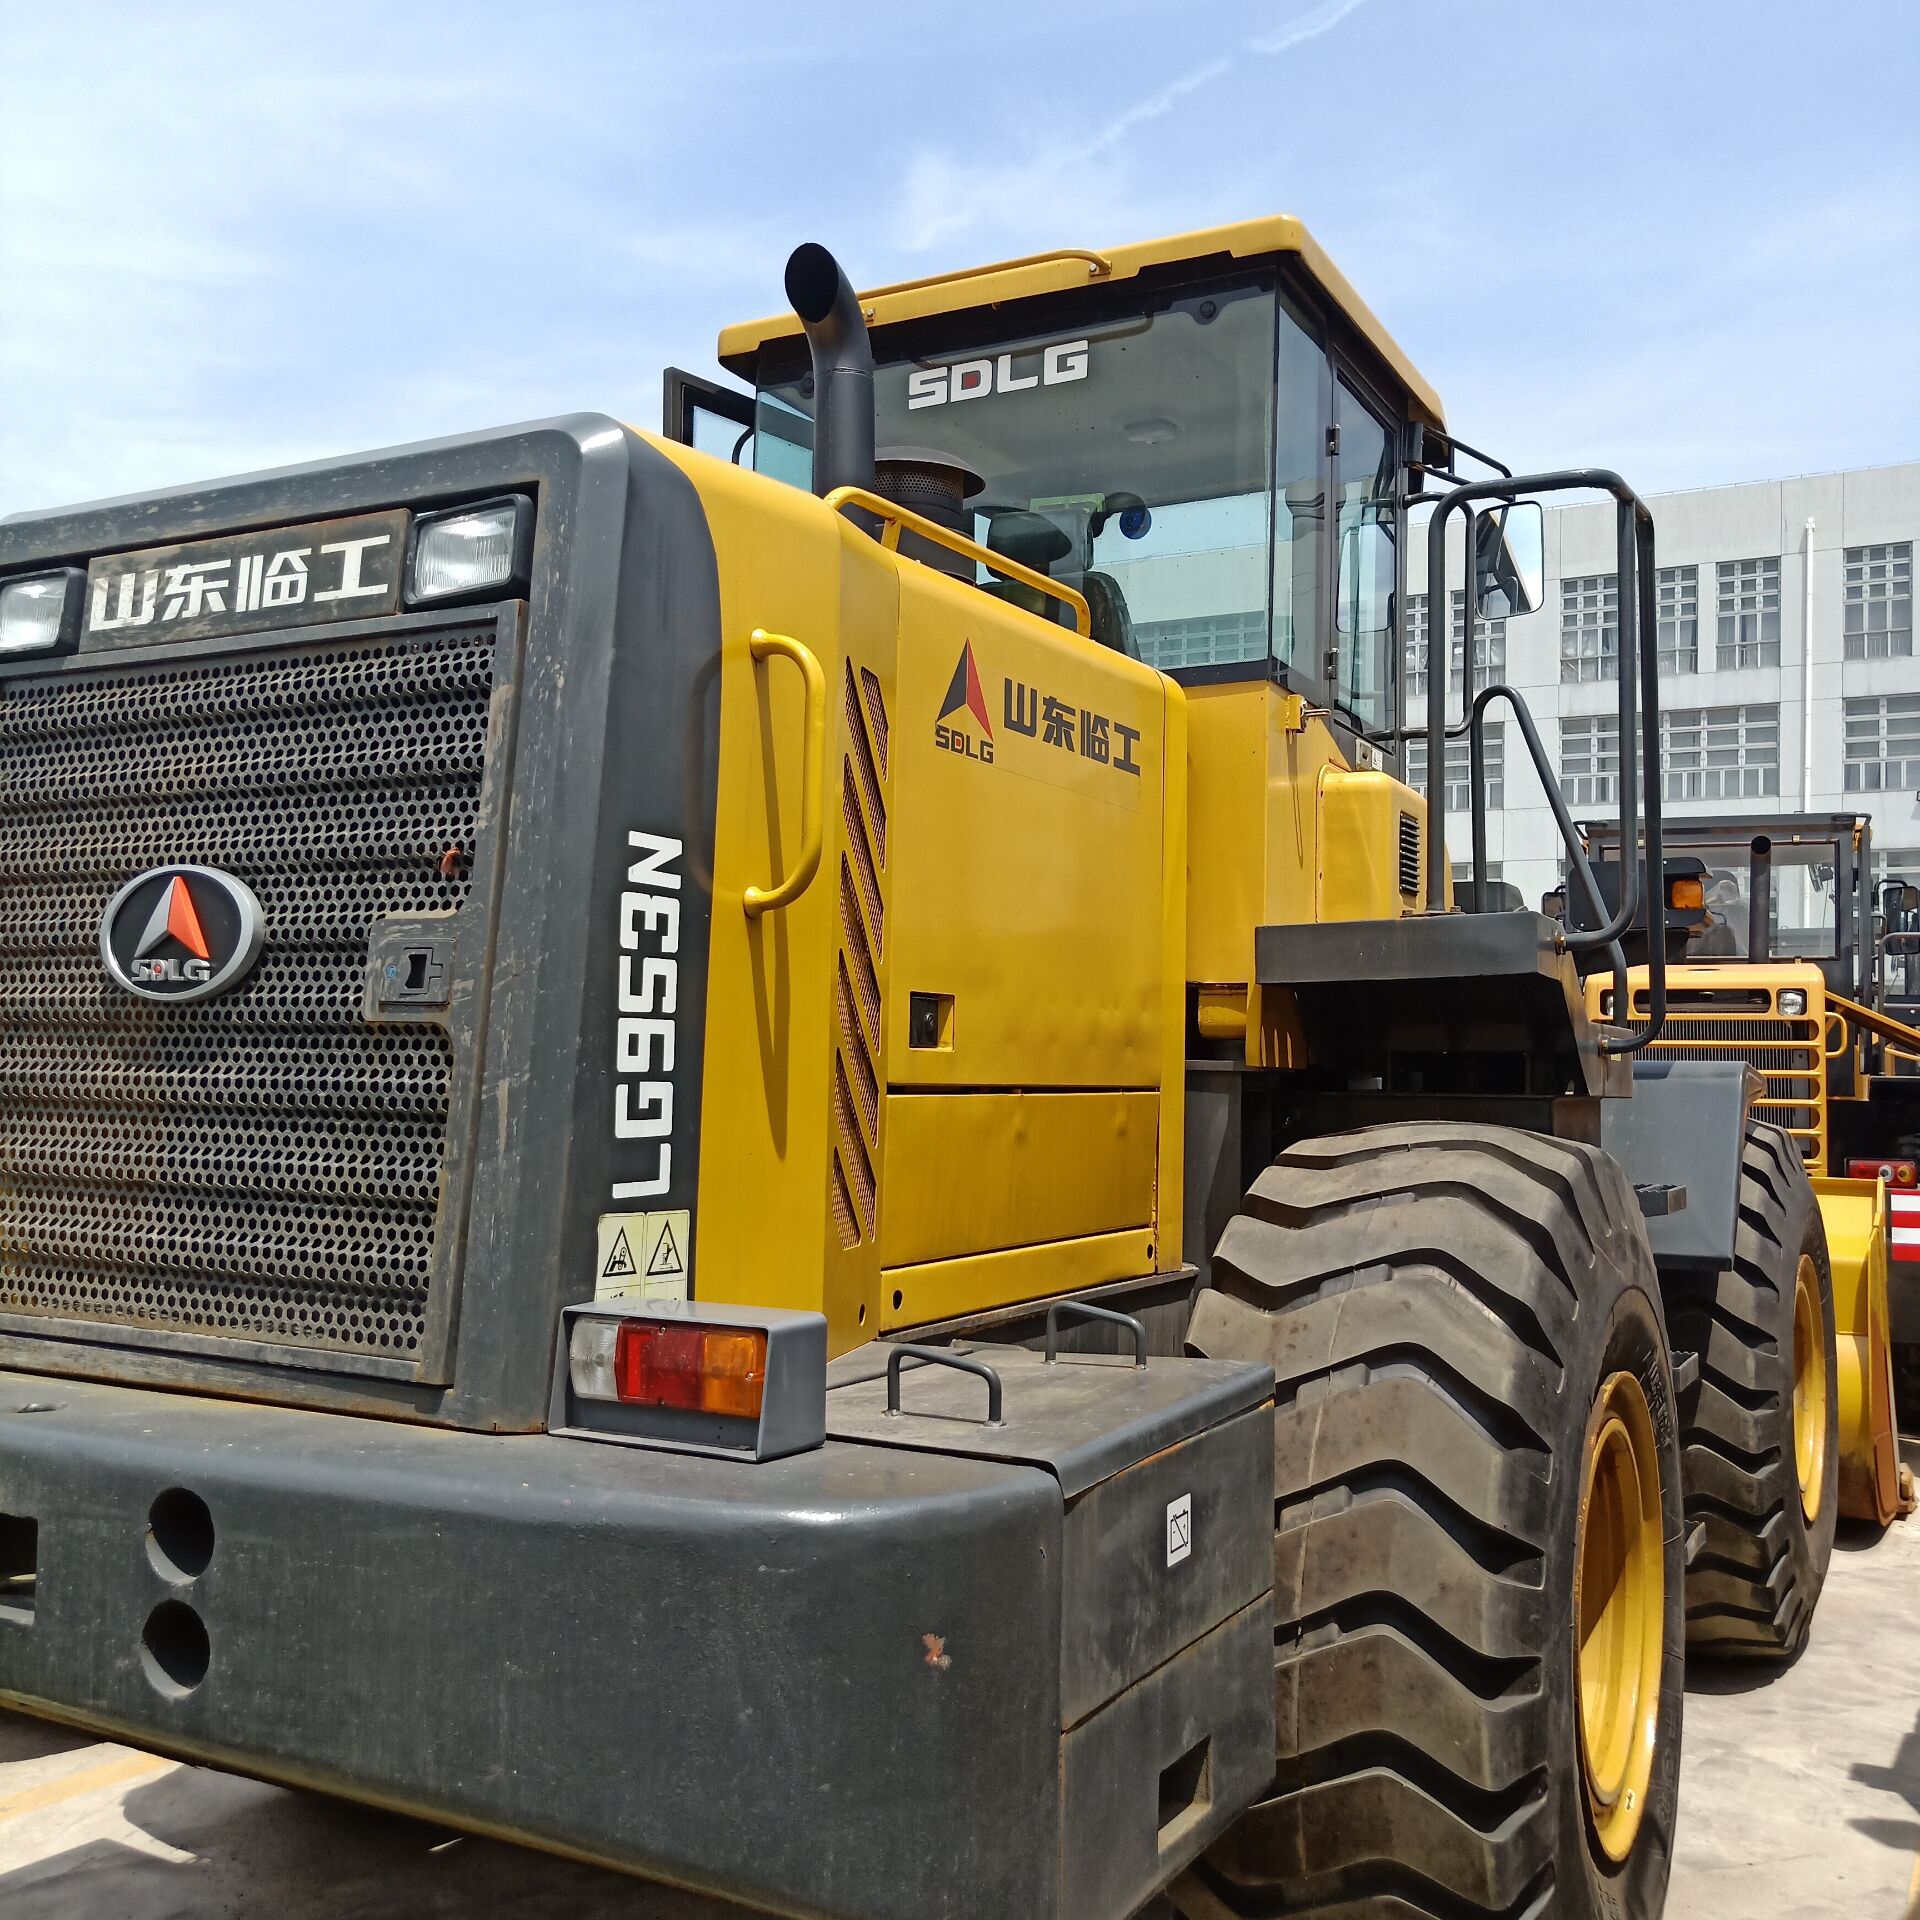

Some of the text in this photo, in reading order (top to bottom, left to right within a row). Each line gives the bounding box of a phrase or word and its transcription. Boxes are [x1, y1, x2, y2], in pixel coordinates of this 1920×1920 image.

[908, 340, 1089, 410] SDLG
[89, 535, 391, 632] 山东临工
[935, 726, 994, 764] SDLG
[1004, 677, 1141, 776] 山东临工
[132, 958, 211, 982] SDLG
[612, 831, 683, 1199] LG953N
